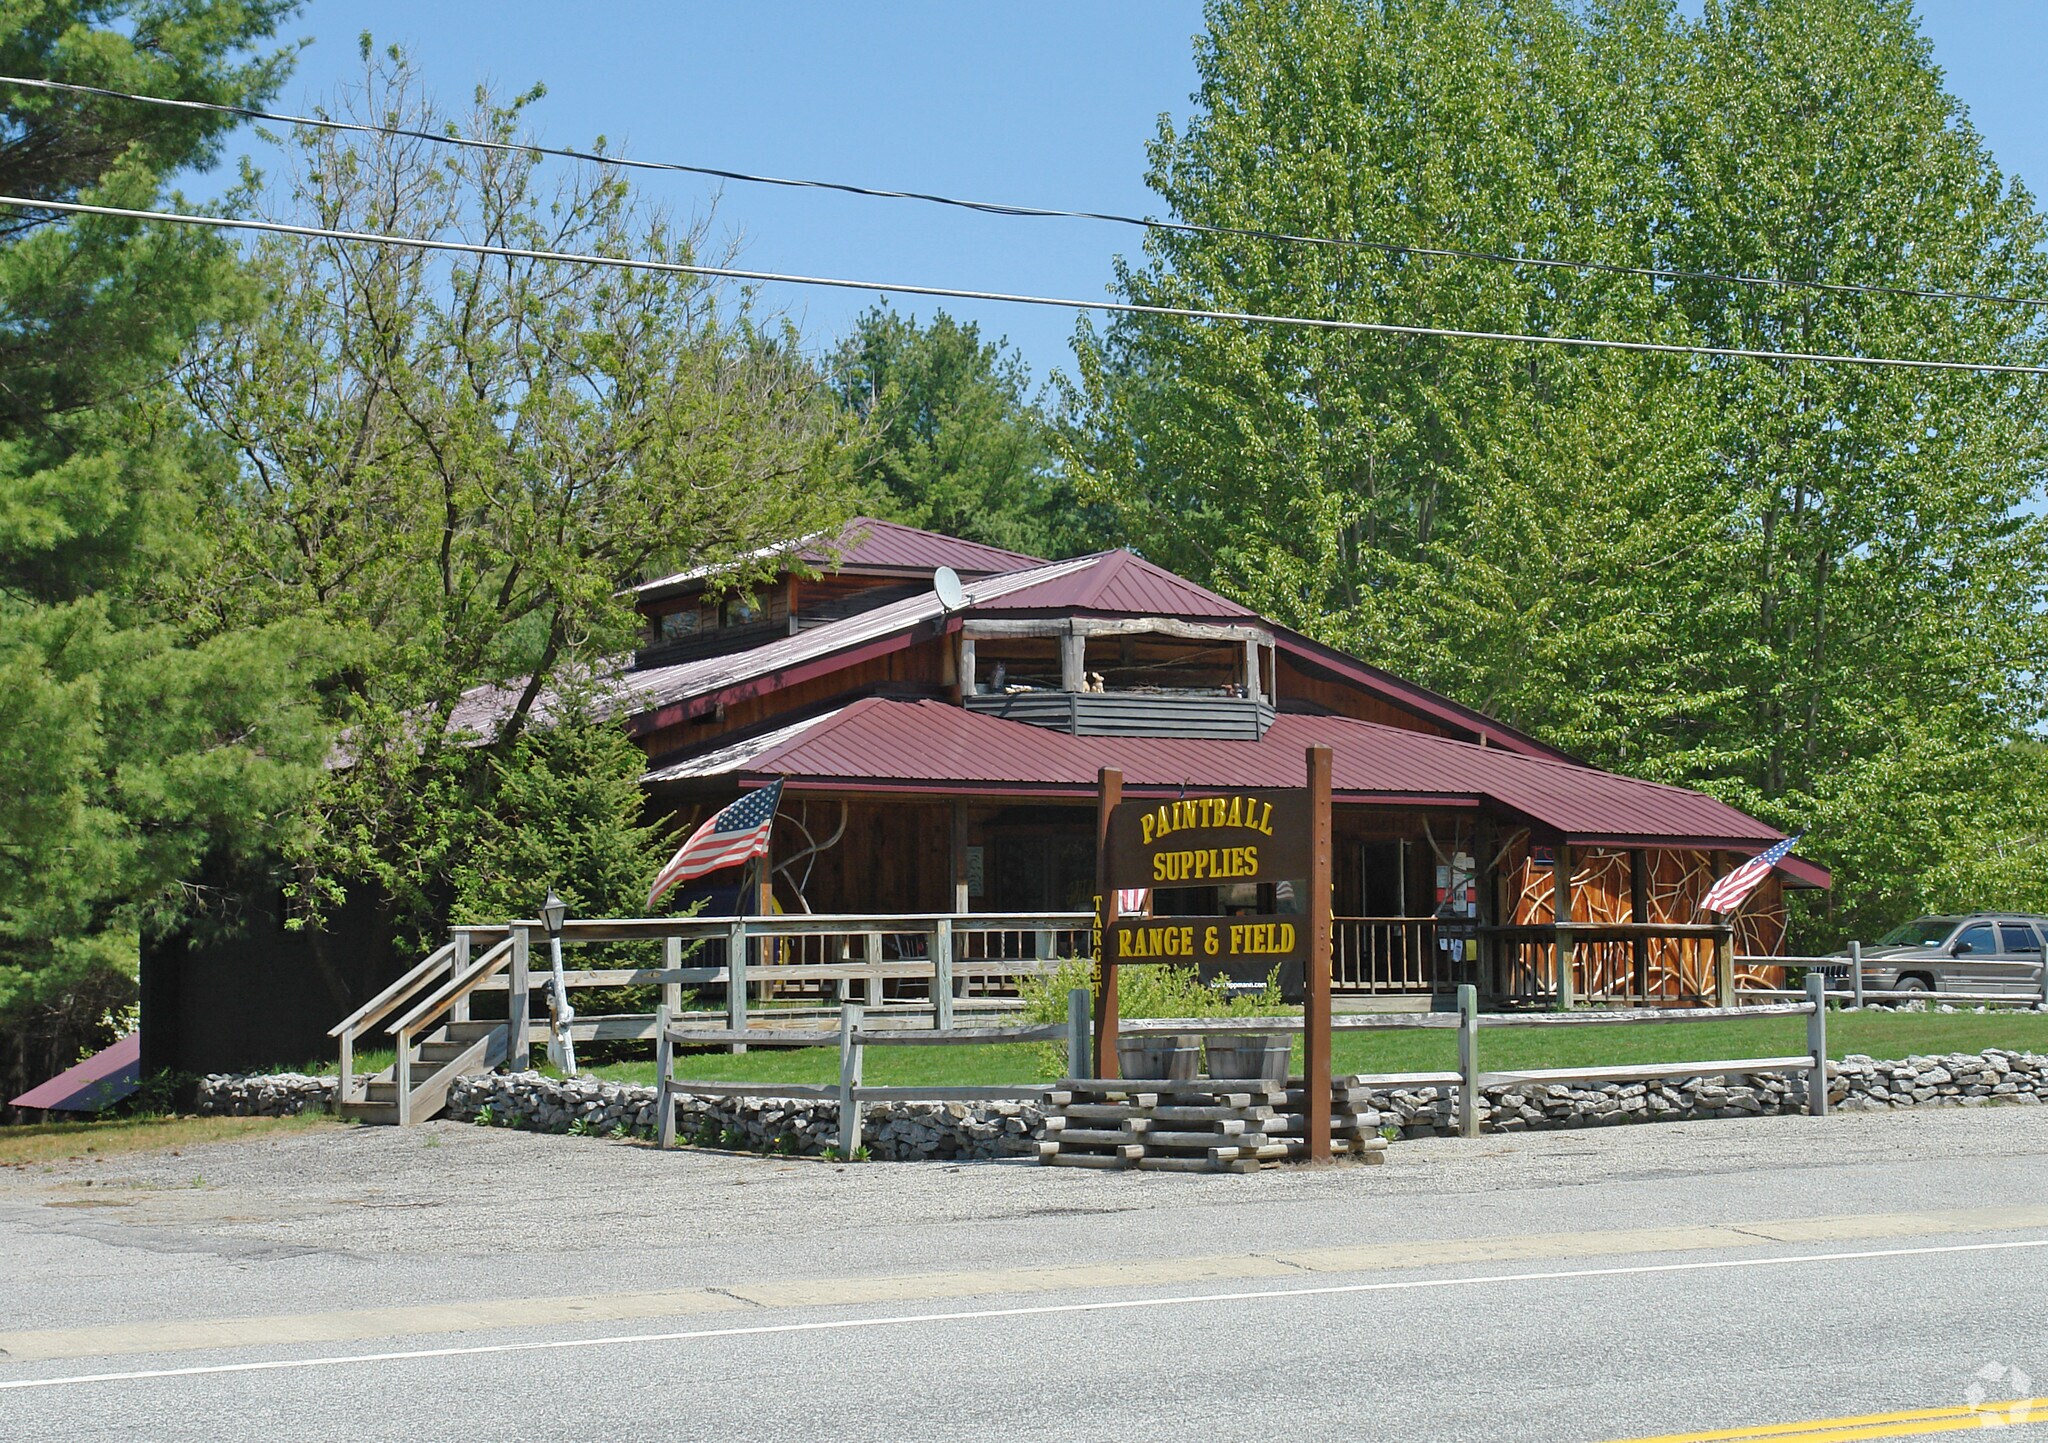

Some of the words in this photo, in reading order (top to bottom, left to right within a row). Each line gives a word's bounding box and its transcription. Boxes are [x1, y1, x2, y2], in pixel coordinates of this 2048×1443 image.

[1140, 796, 1273, 845] PAINTBALL
[1153, 846, 1259, 881] SUPPLIES
[1093, 895, 1103, 998] TARGET
[1118, 926, 1194, 957] RANGE
[1204, 926, 1219, 955] &
[1230, 923, 1296, 954] FIELD
